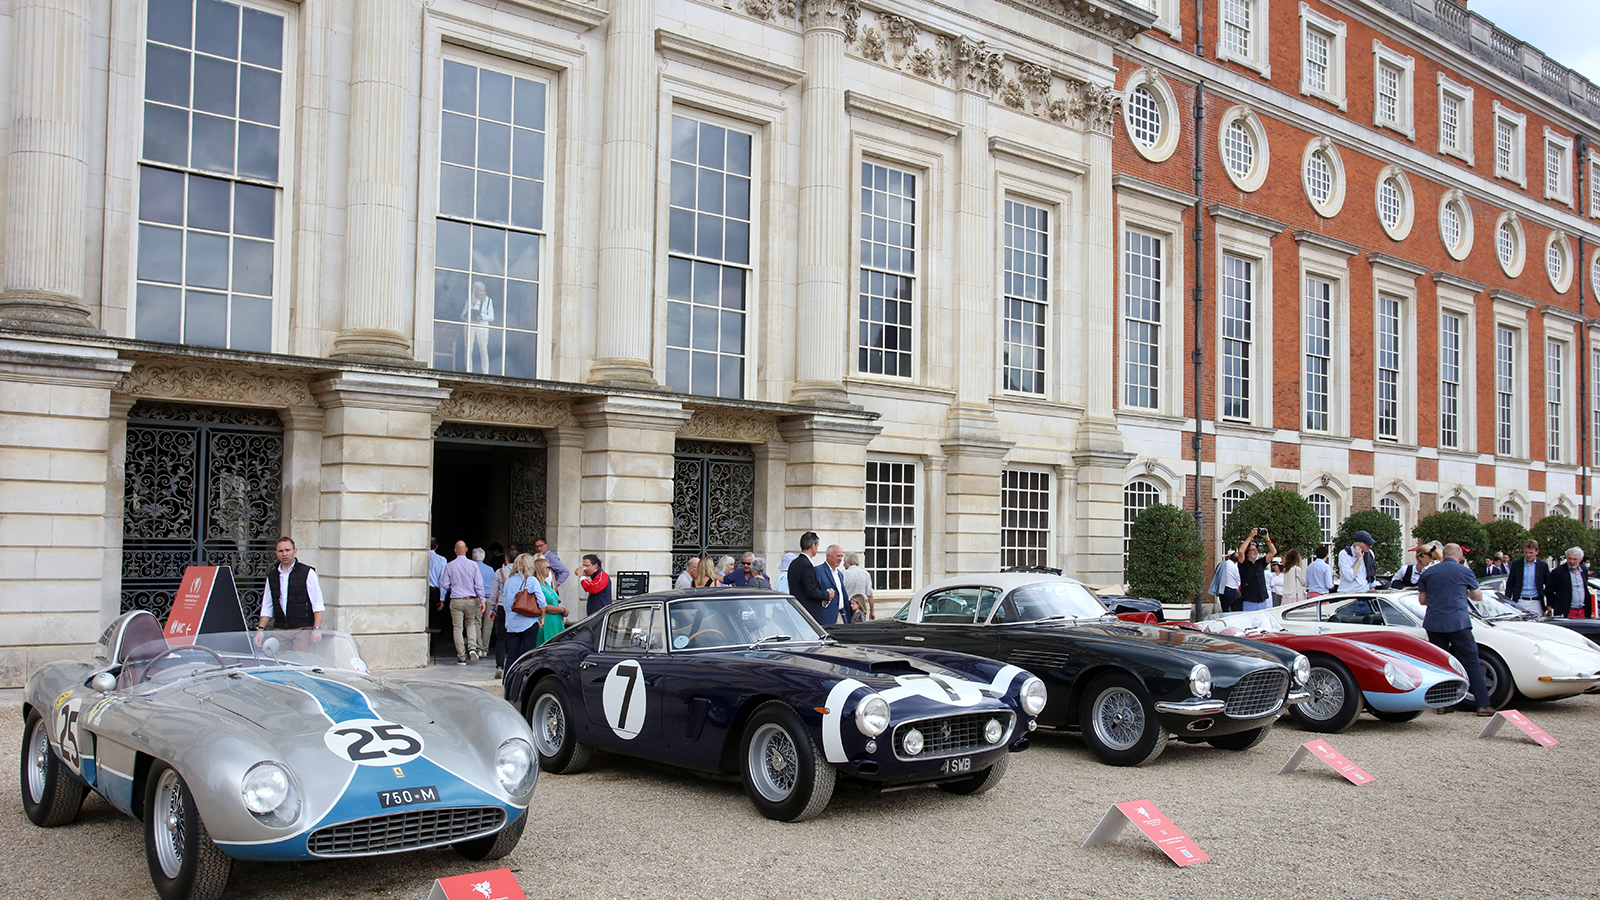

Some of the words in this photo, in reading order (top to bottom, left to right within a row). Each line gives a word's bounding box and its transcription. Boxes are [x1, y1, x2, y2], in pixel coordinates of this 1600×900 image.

[616, 665, 638, 729] 7
[60, 704, 80, 769] 25
[333, 724, 422, 761] 25
[951, 757, 971, 772] SWB
